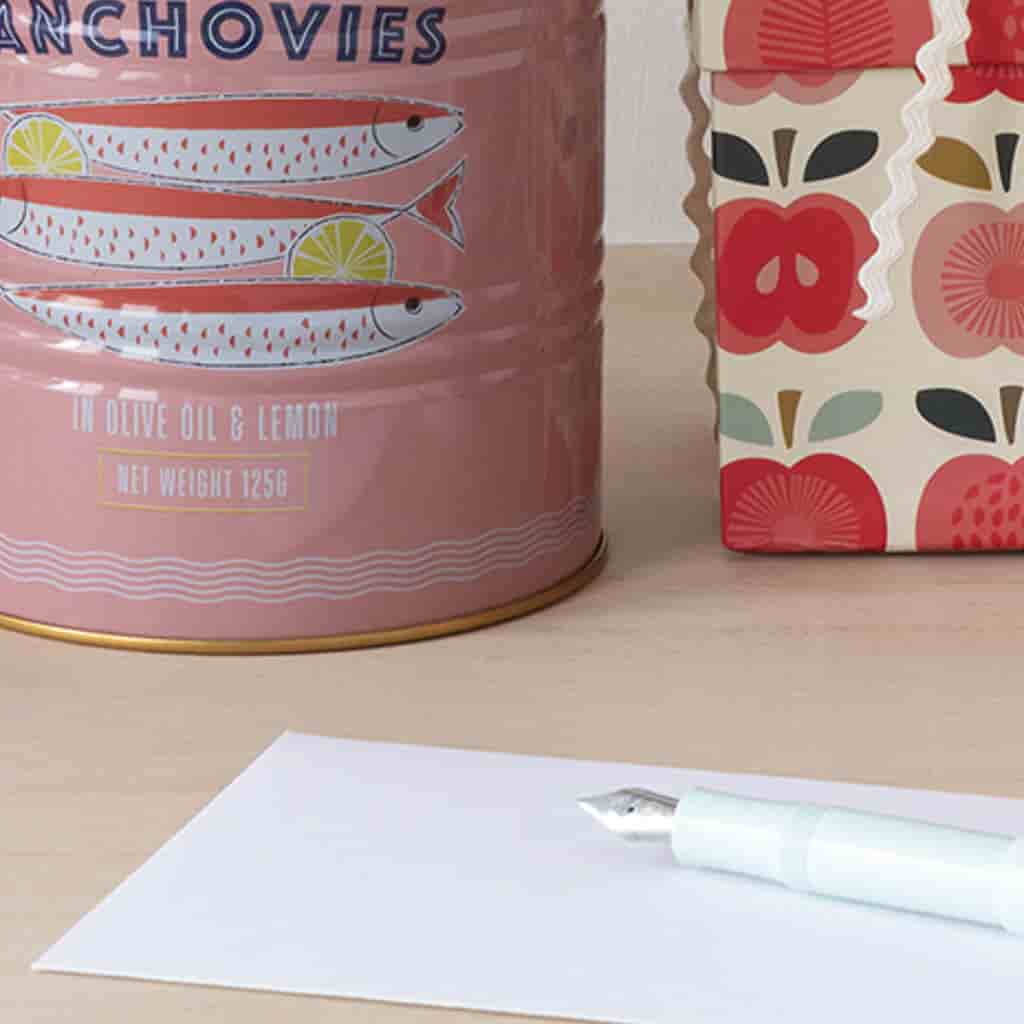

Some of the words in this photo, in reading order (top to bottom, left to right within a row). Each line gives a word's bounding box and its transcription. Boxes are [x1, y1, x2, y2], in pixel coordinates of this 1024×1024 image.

[71, 394, 95, 433] IN
[106, 398, 169, 439] OLIVE
[180, 403, 218, 441] OIL
[231, 403, 245, 441] &
[257, 400, 338, 441] LEMON
[116, 463, 150, 496] NET
[159, 466, 234, 499] WEIGHT
[240, 467, 288, 499] 125G
